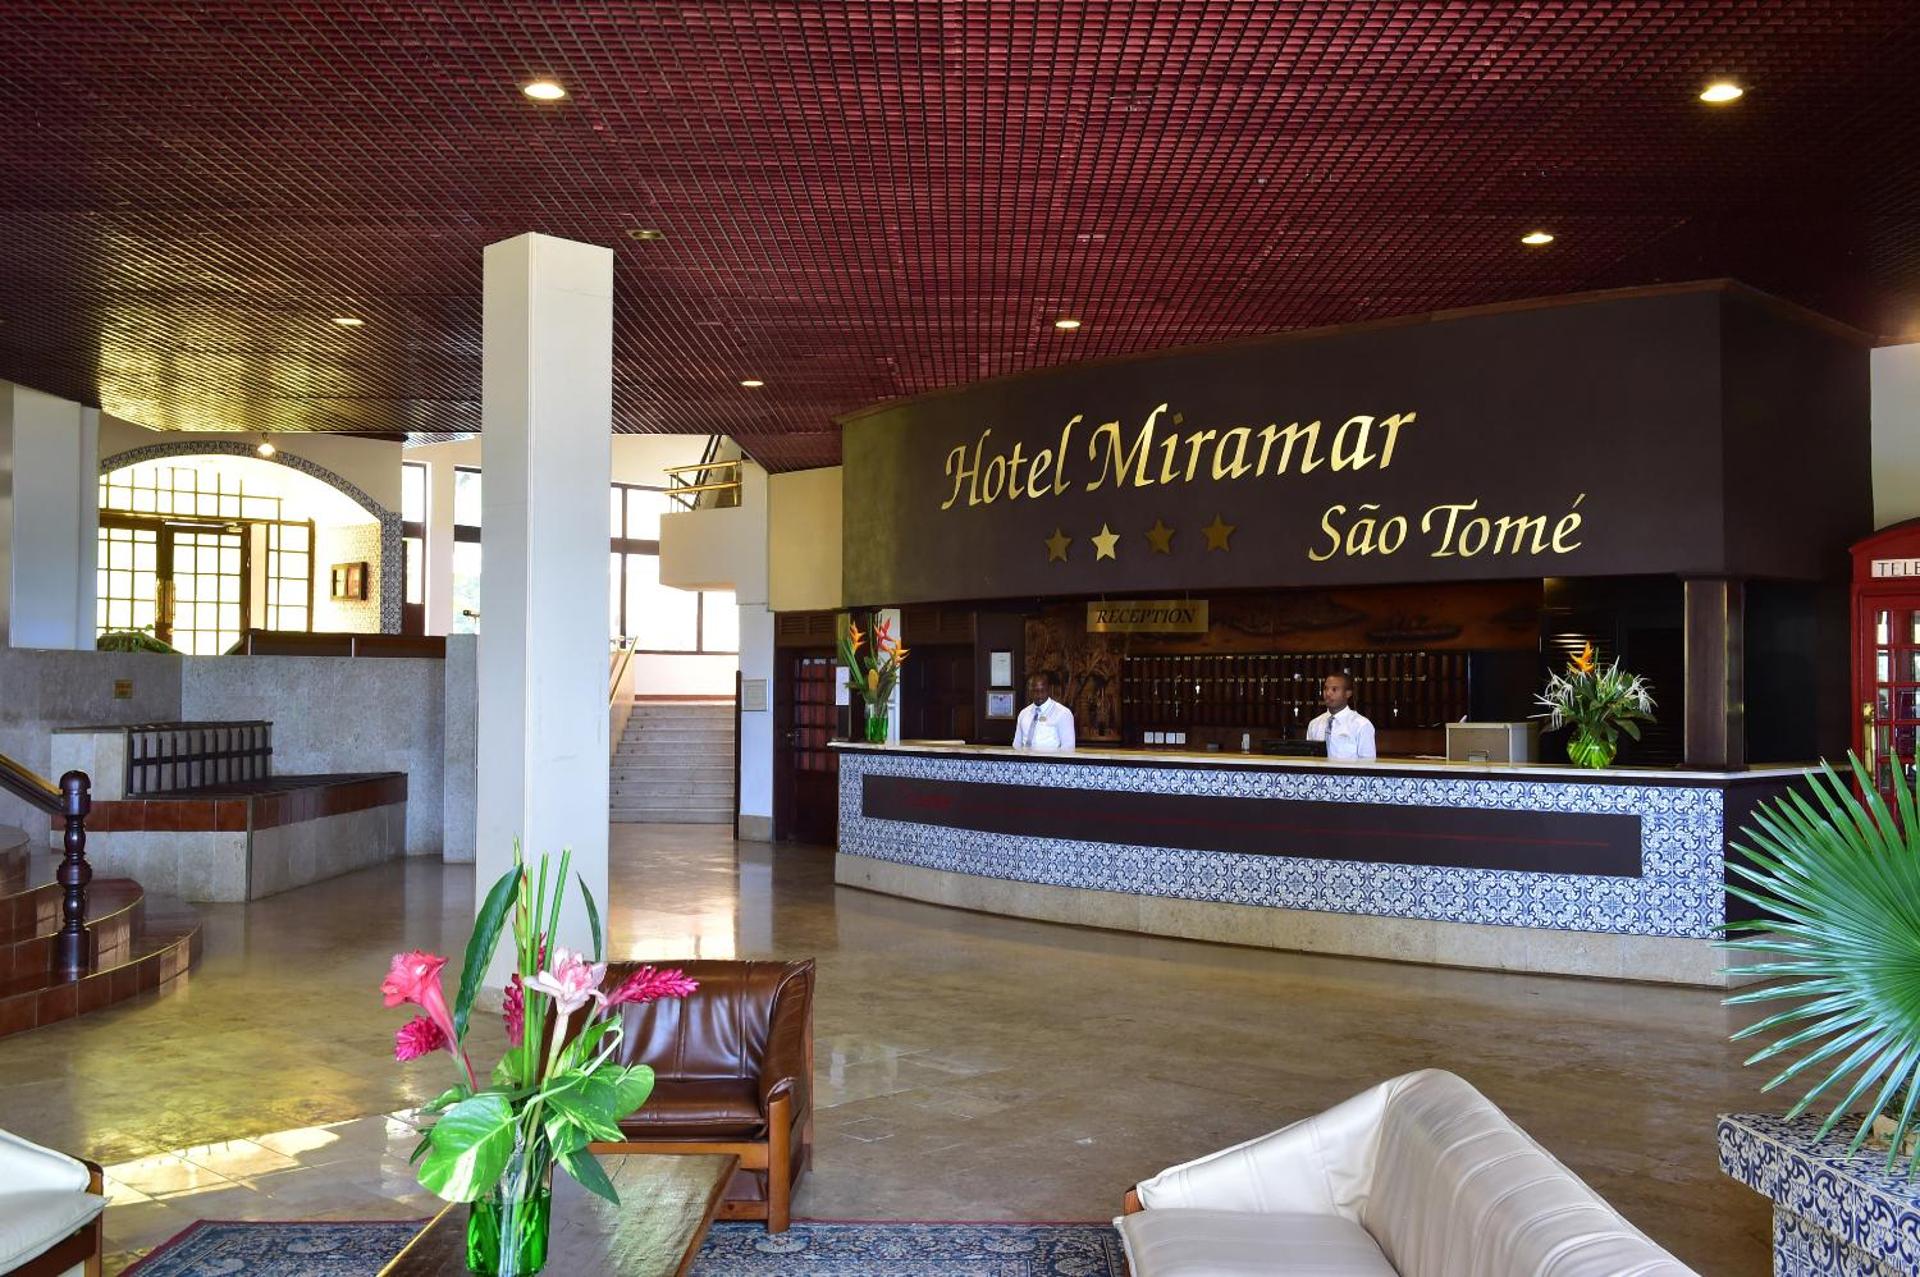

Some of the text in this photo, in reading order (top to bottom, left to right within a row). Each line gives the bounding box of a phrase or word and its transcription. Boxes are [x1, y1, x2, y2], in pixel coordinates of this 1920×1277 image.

[941, 403, 1417, 511] Hotel Miramar
[1308, 493, 1586, 562] São Tomé
[1096, 607, 1195, 624] RECEPTION
